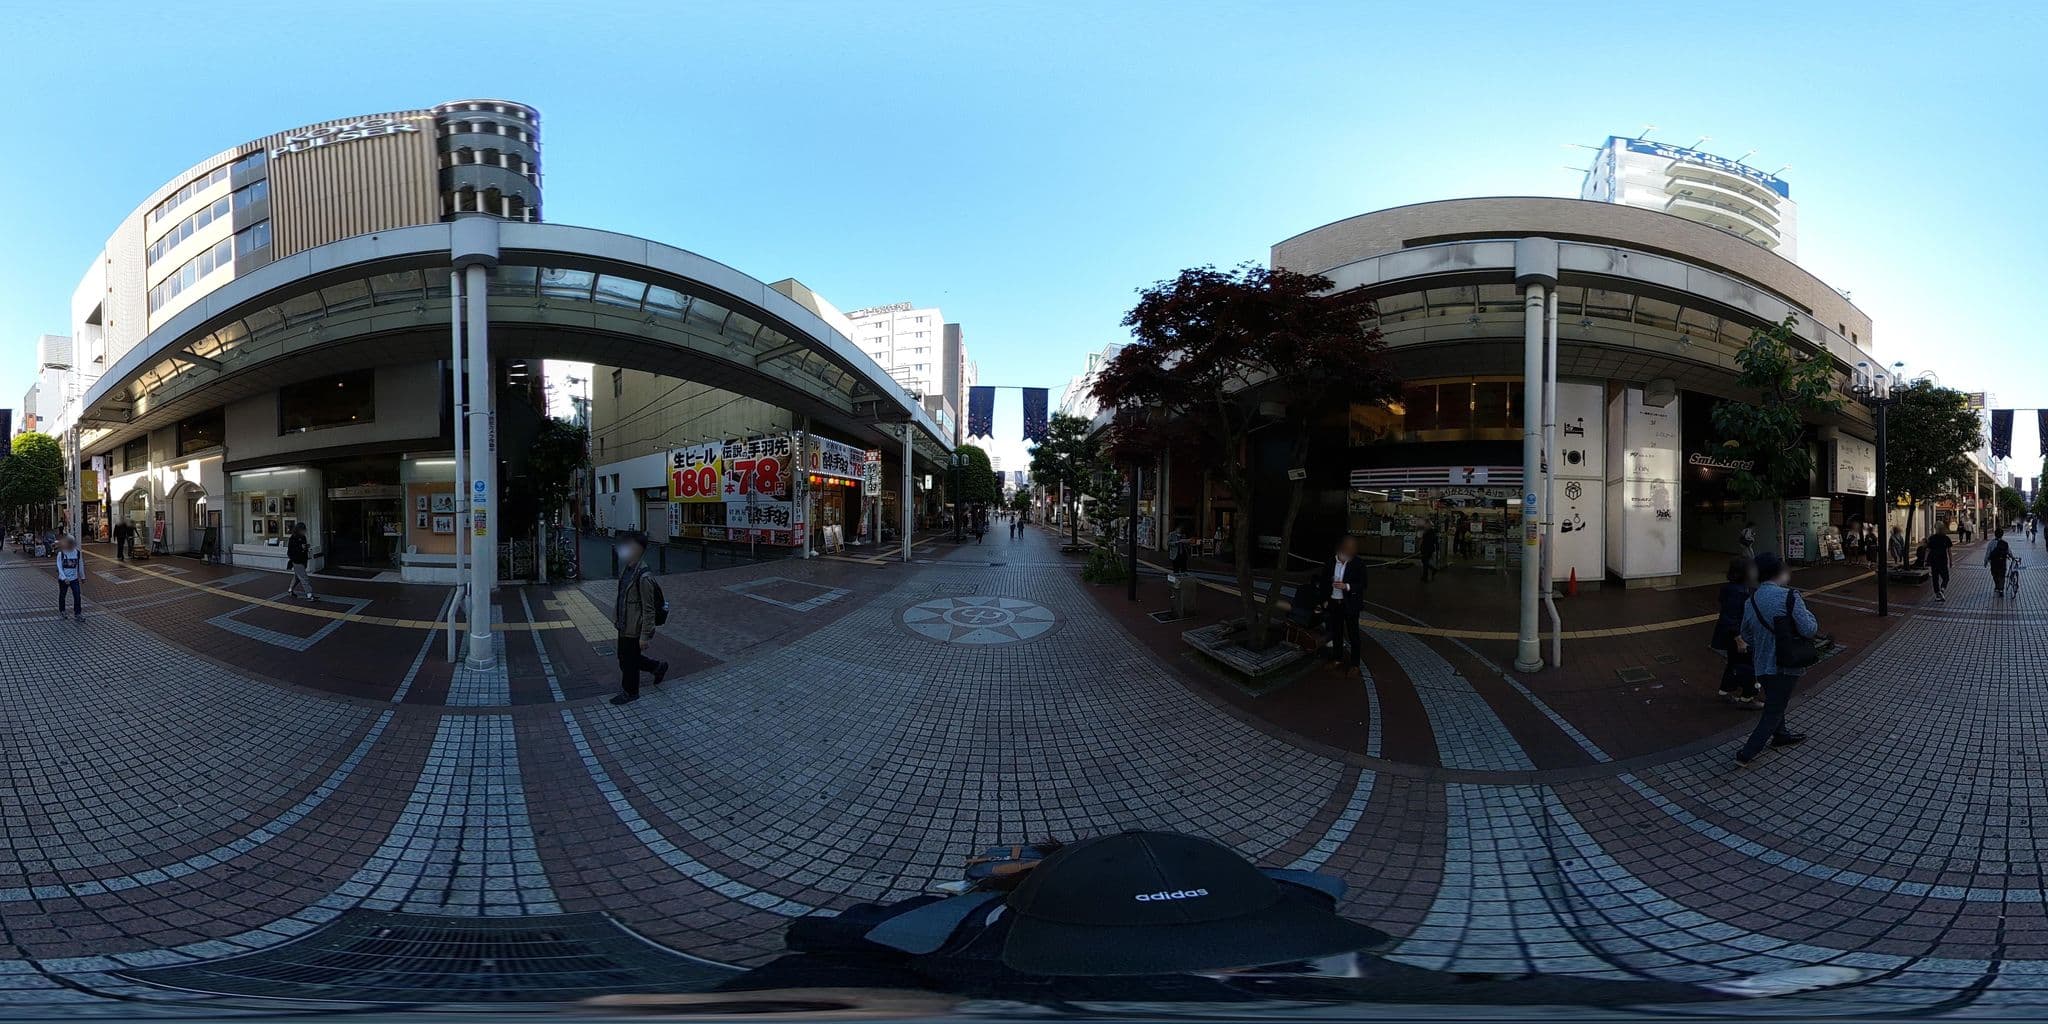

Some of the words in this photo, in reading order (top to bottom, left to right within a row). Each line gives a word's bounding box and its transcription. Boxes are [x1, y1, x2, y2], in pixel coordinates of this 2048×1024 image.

[673, 447, 718, 469] 生ビール
[722, 438, 790, 459] 伝説の手羽先
[1135, 888, 1209, 901] adidas
